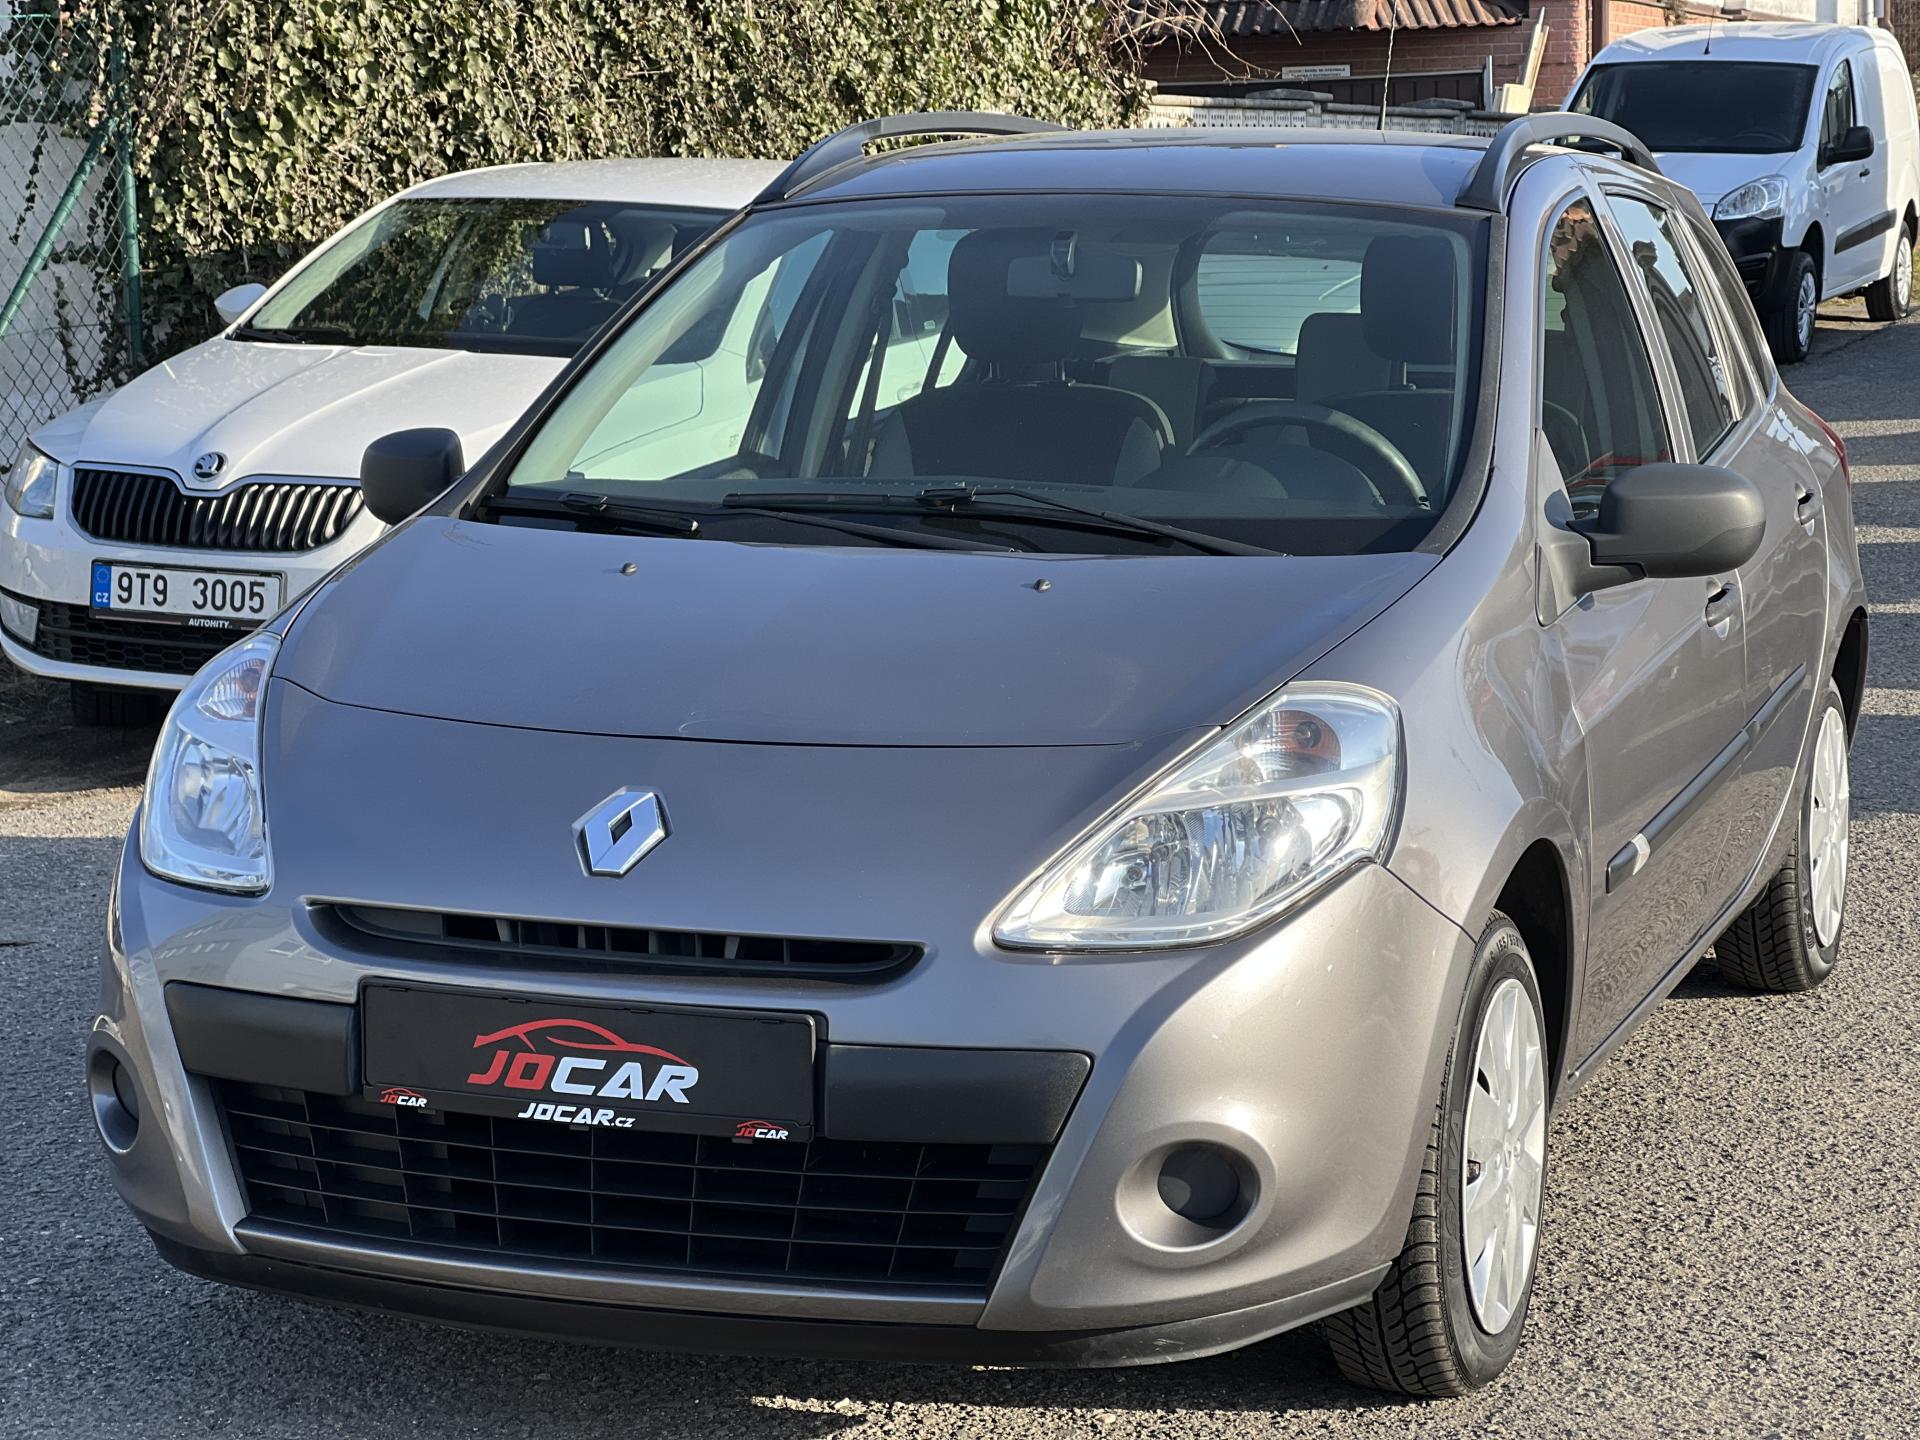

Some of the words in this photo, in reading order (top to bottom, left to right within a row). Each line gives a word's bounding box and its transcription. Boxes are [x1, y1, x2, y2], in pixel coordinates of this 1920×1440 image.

[95, 591, 109, 603] CZ
[117, 571, 168, 607] 9T9
[192, 577, 266, 614] 3005
[466, 1050, 699, 1104] JOCAR
[380, 1092, 428, 1108] JOCAR
[735, 1126, 789, 1141] JOCAR
